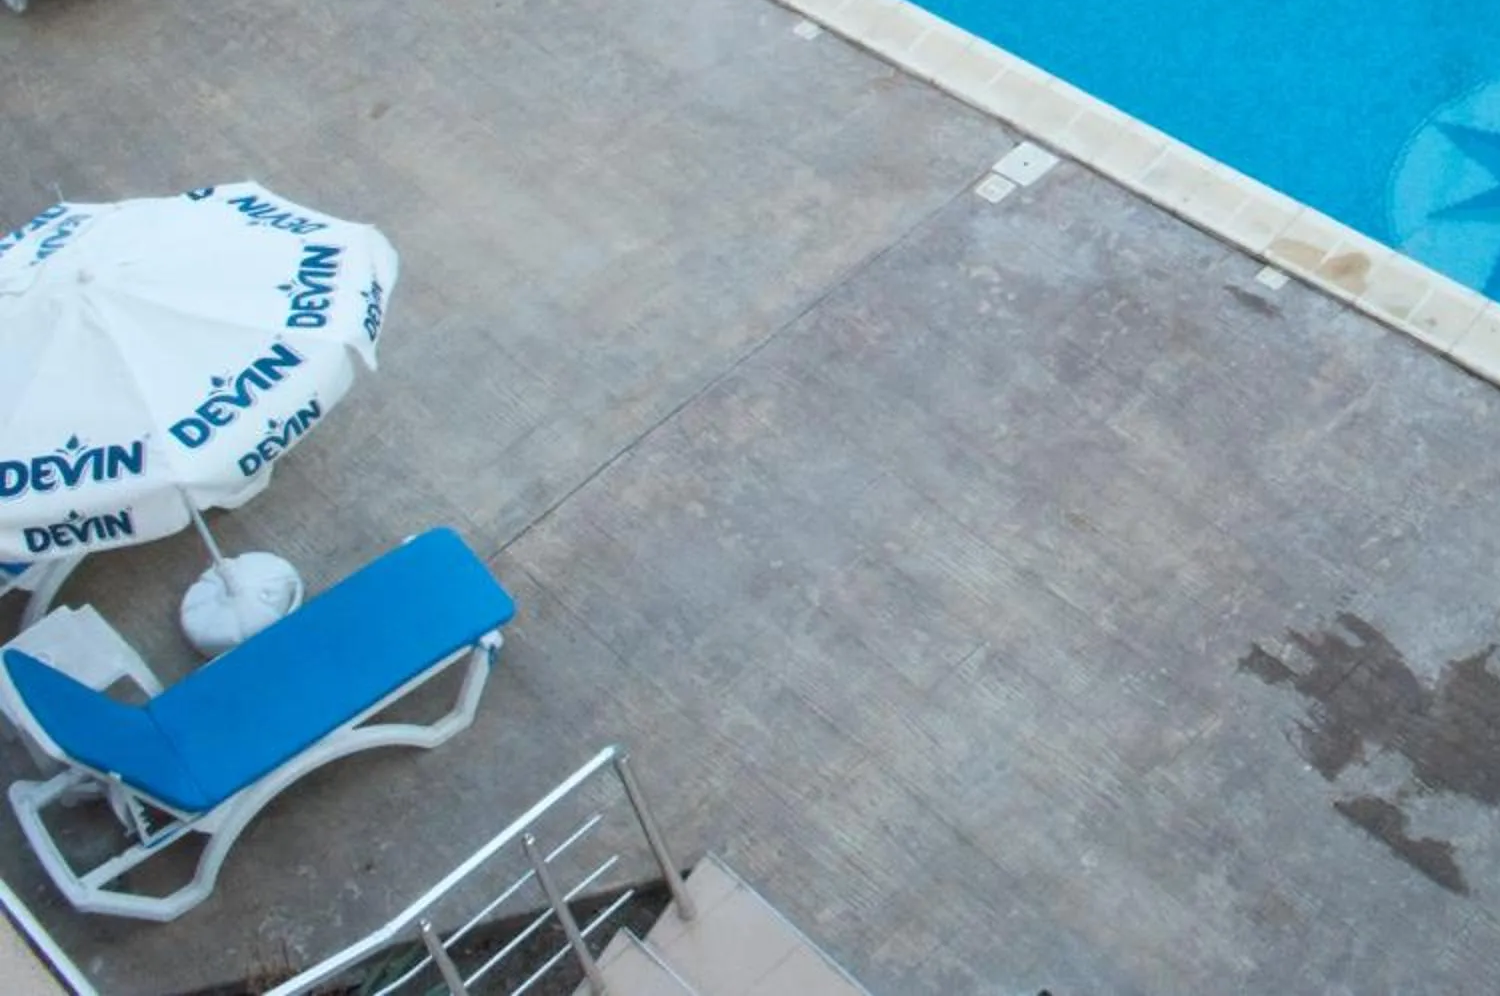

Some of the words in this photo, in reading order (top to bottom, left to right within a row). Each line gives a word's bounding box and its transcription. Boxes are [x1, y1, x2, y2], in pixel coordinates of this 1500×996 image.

[229, 195, 328, 235] DEVIN
[287, 245, 340, 330] DEVIN
[168, 343, 302, 449] DEVIN
[0, 441, 144, 497] DEVIN
[238, 400, 320, 477] DEVIN
[24, 511, 135, 553] DEVIN
